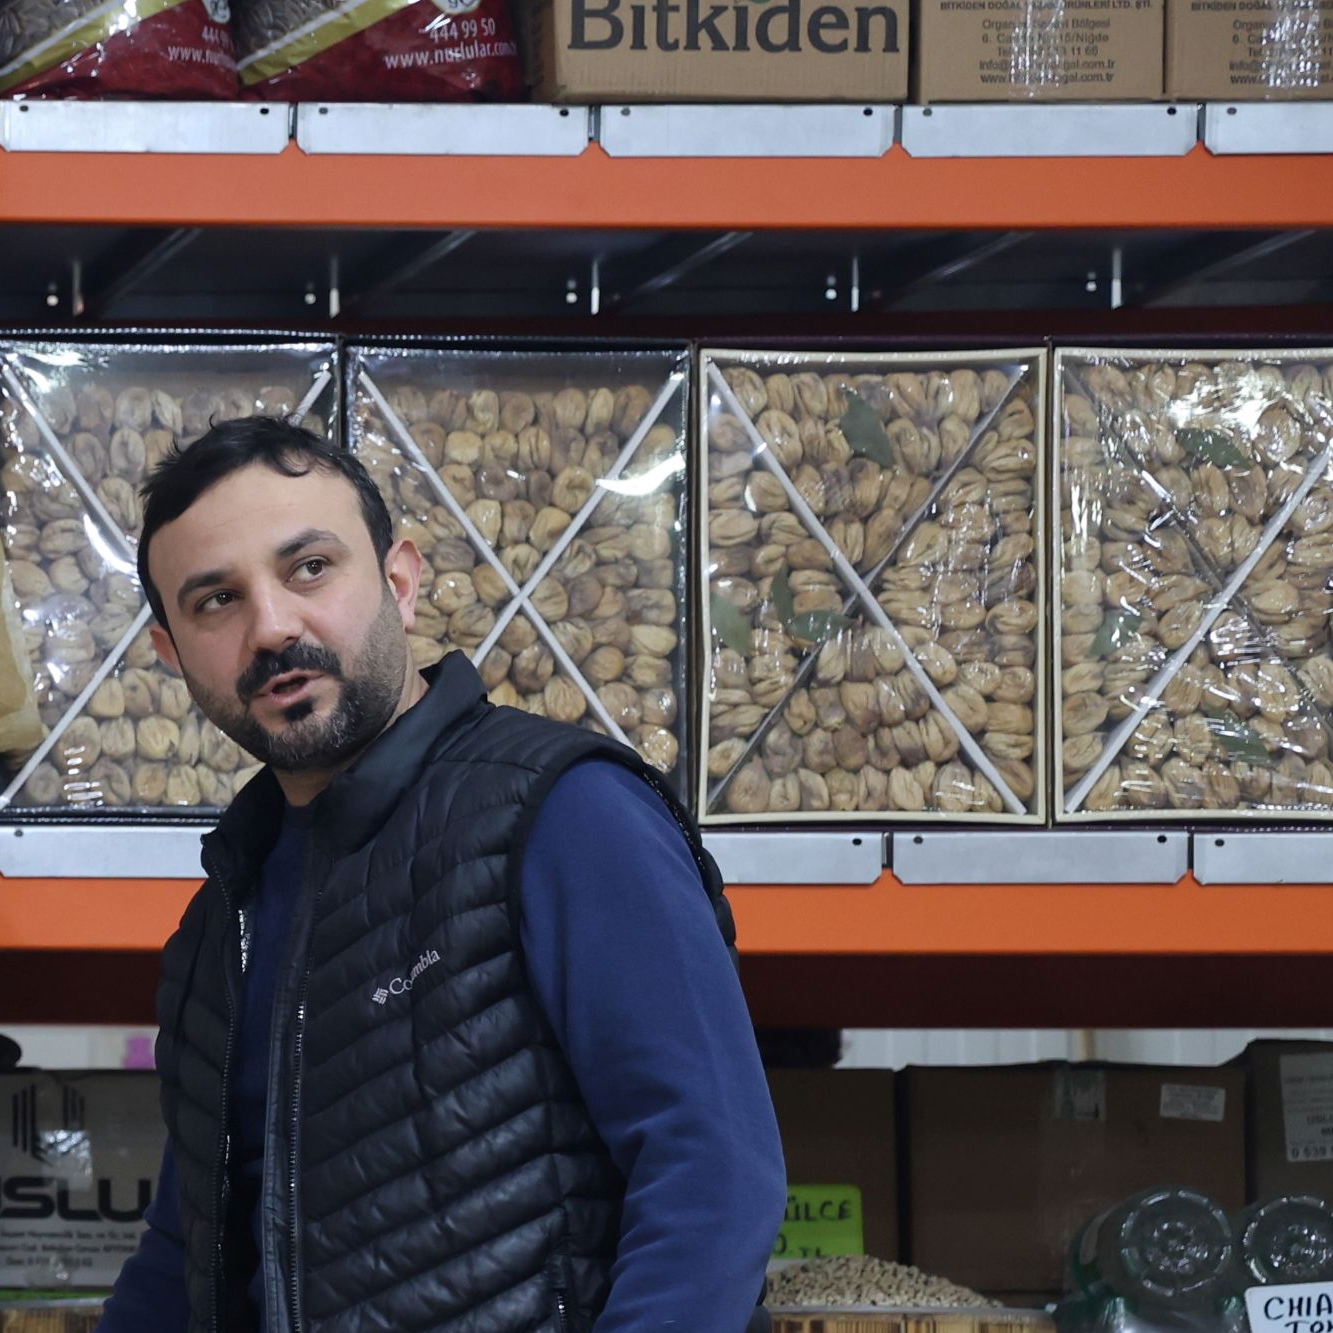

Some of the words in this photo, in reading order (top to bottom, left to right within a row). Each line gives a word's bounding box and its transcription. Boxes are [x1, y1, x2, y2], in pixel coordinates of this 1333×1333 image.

[461, 21, 479, 41] 99
[481, 17, 496, 38] 50
[566, 0, 900, 53] Bitkiden
[1263, 1292, 1333, 1321] CHIA
